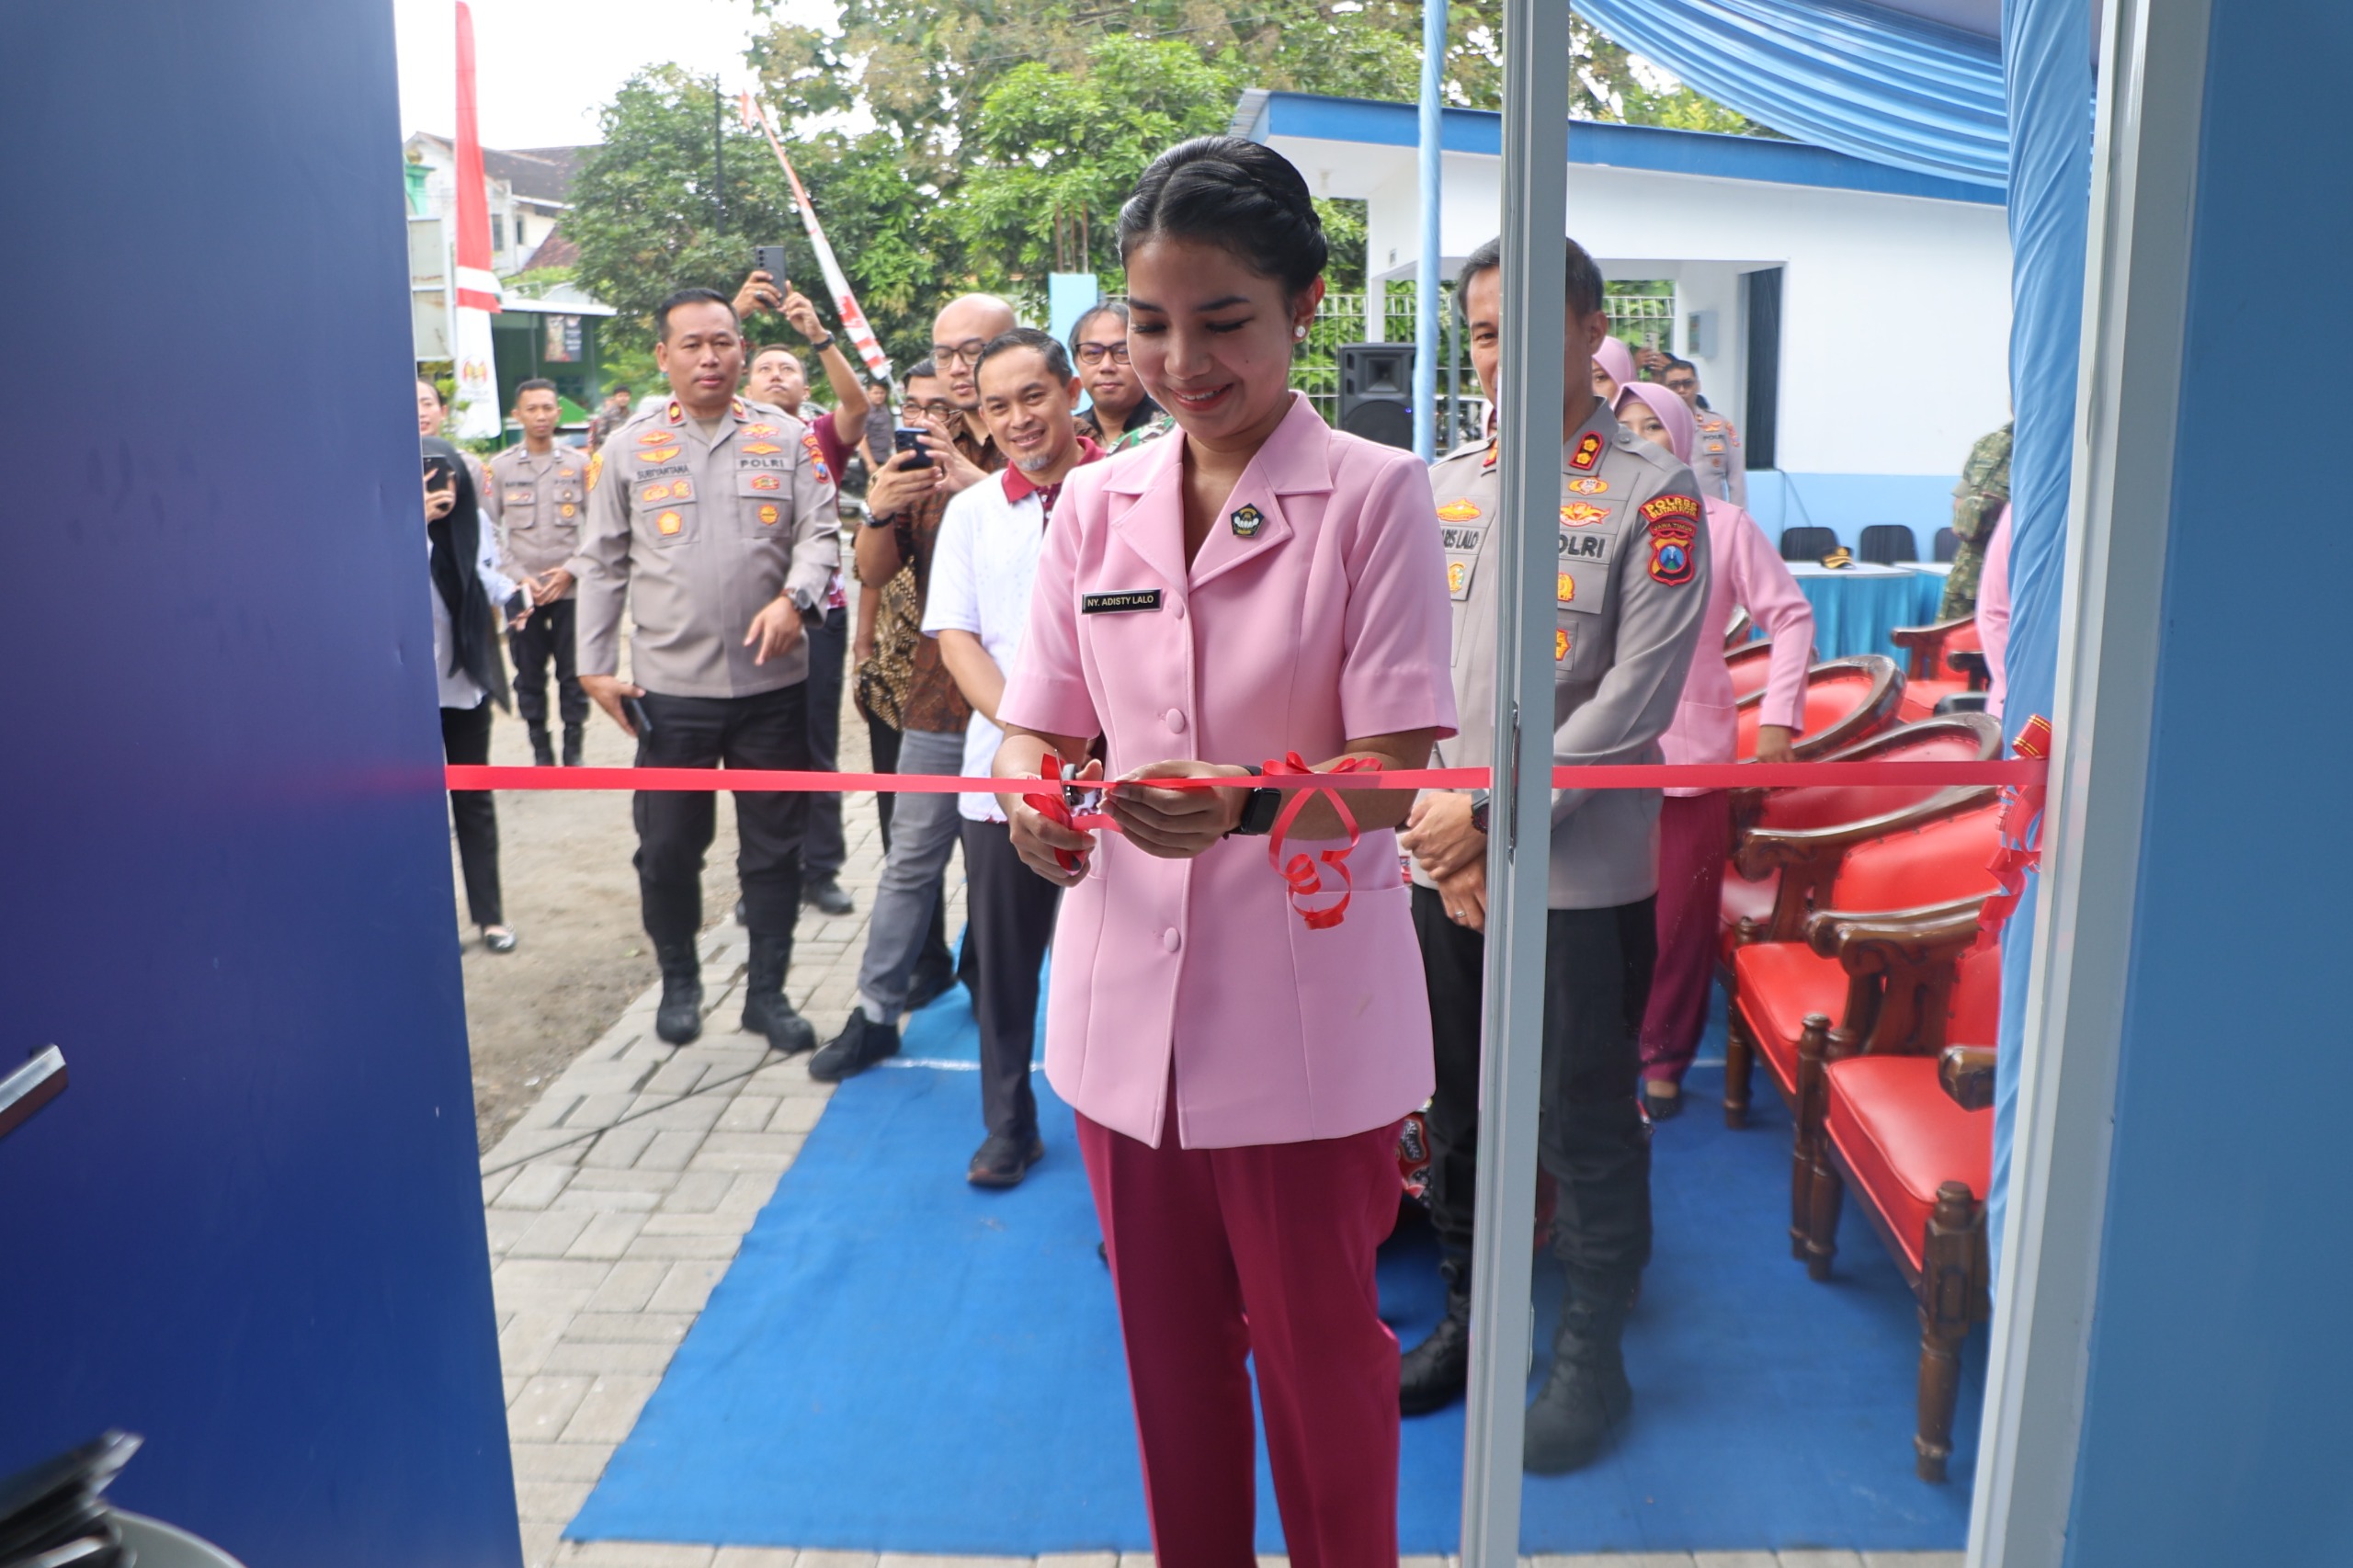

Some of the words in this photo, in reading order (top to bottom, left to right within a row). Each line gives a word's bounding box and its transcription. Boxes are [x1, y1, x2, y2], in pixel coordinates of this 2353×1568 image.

[740, 459, 784, 468] POLRI
[1645, 497, 1698, 513] POLRES
[1650, 505, 1678, 518] BLITAR
[1654, 522, 1672, 531] JAWA
[1673, 522, 1693, 532] TIMUR
[1456, 529, 1480, 550] LALO
[1087, 598, 1100, 608] NY.
[1101, 597, 1131, 606] ADISTY
[1132, 595, 1154, 605] LALO
